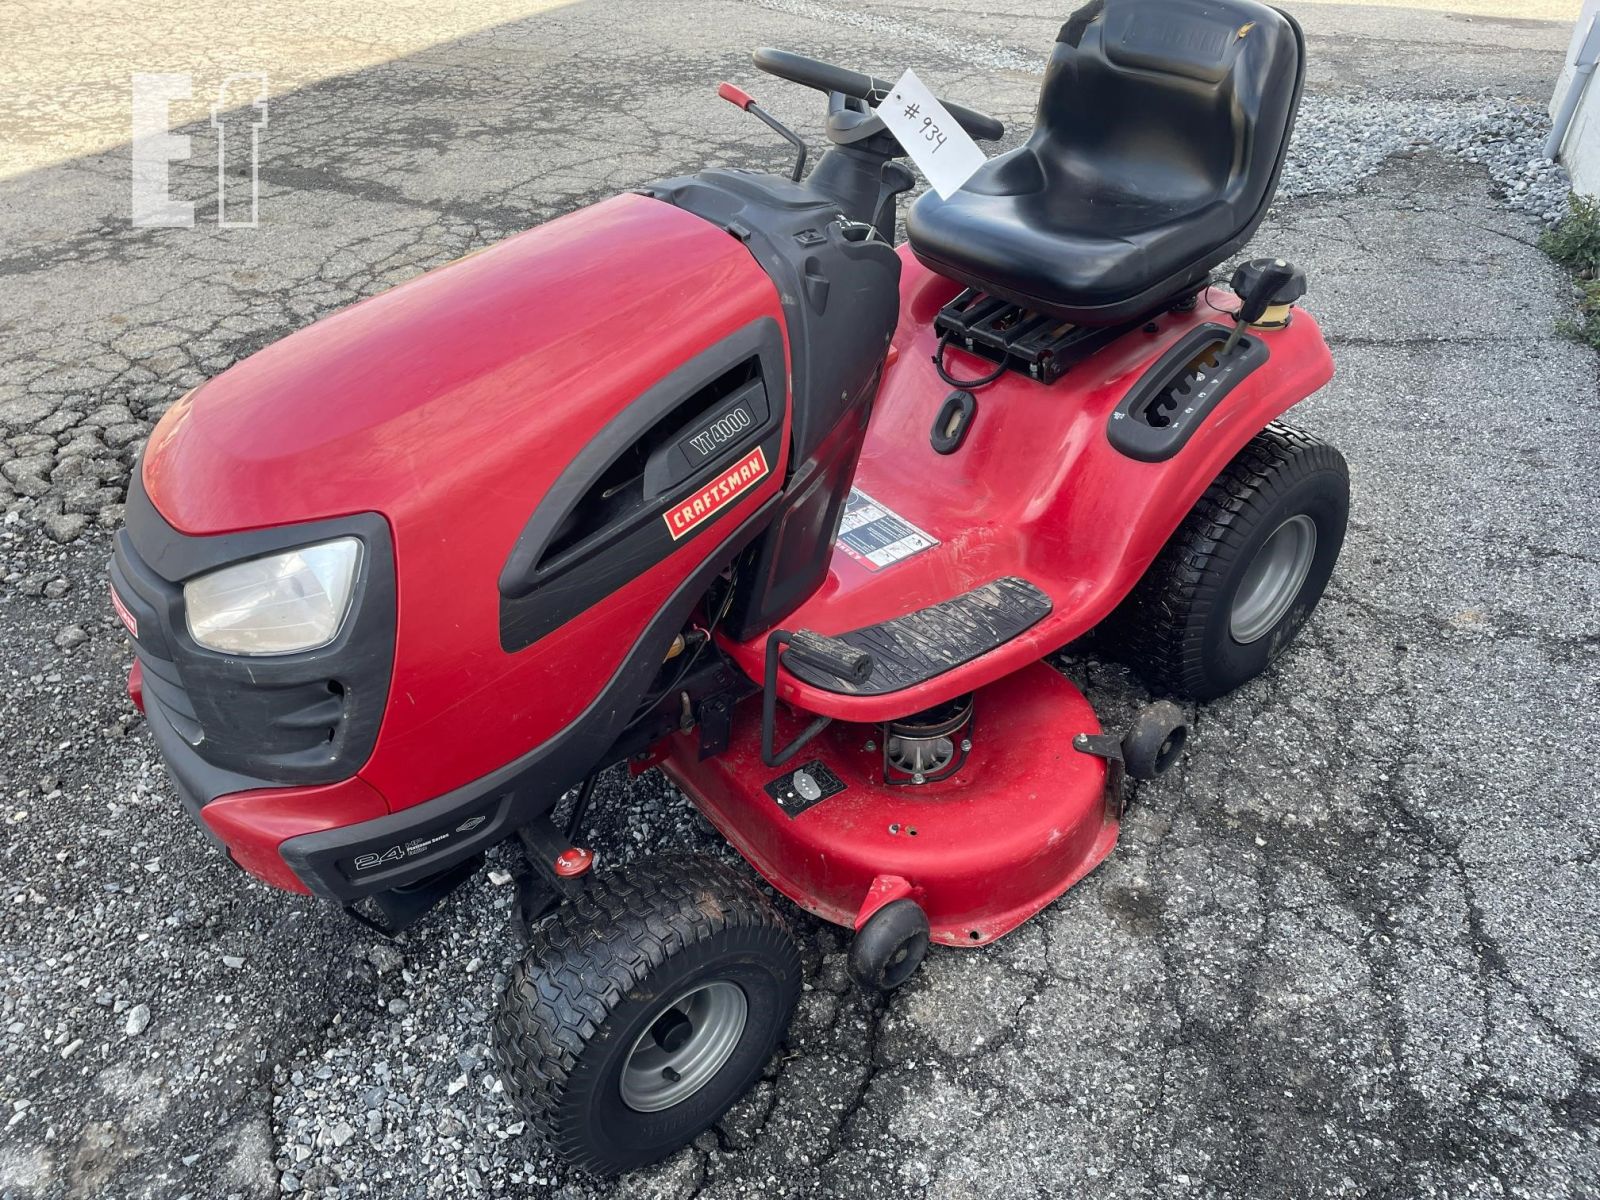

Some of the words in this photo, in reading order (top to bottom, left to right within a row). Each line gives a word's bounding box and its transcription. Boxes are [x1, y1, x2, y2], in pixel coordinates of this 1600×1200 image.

[710, 408, 750, 442] 4000
[673, 457, 761, 528] CRAFTSMAN
[354, 845, 405, 870] 24
